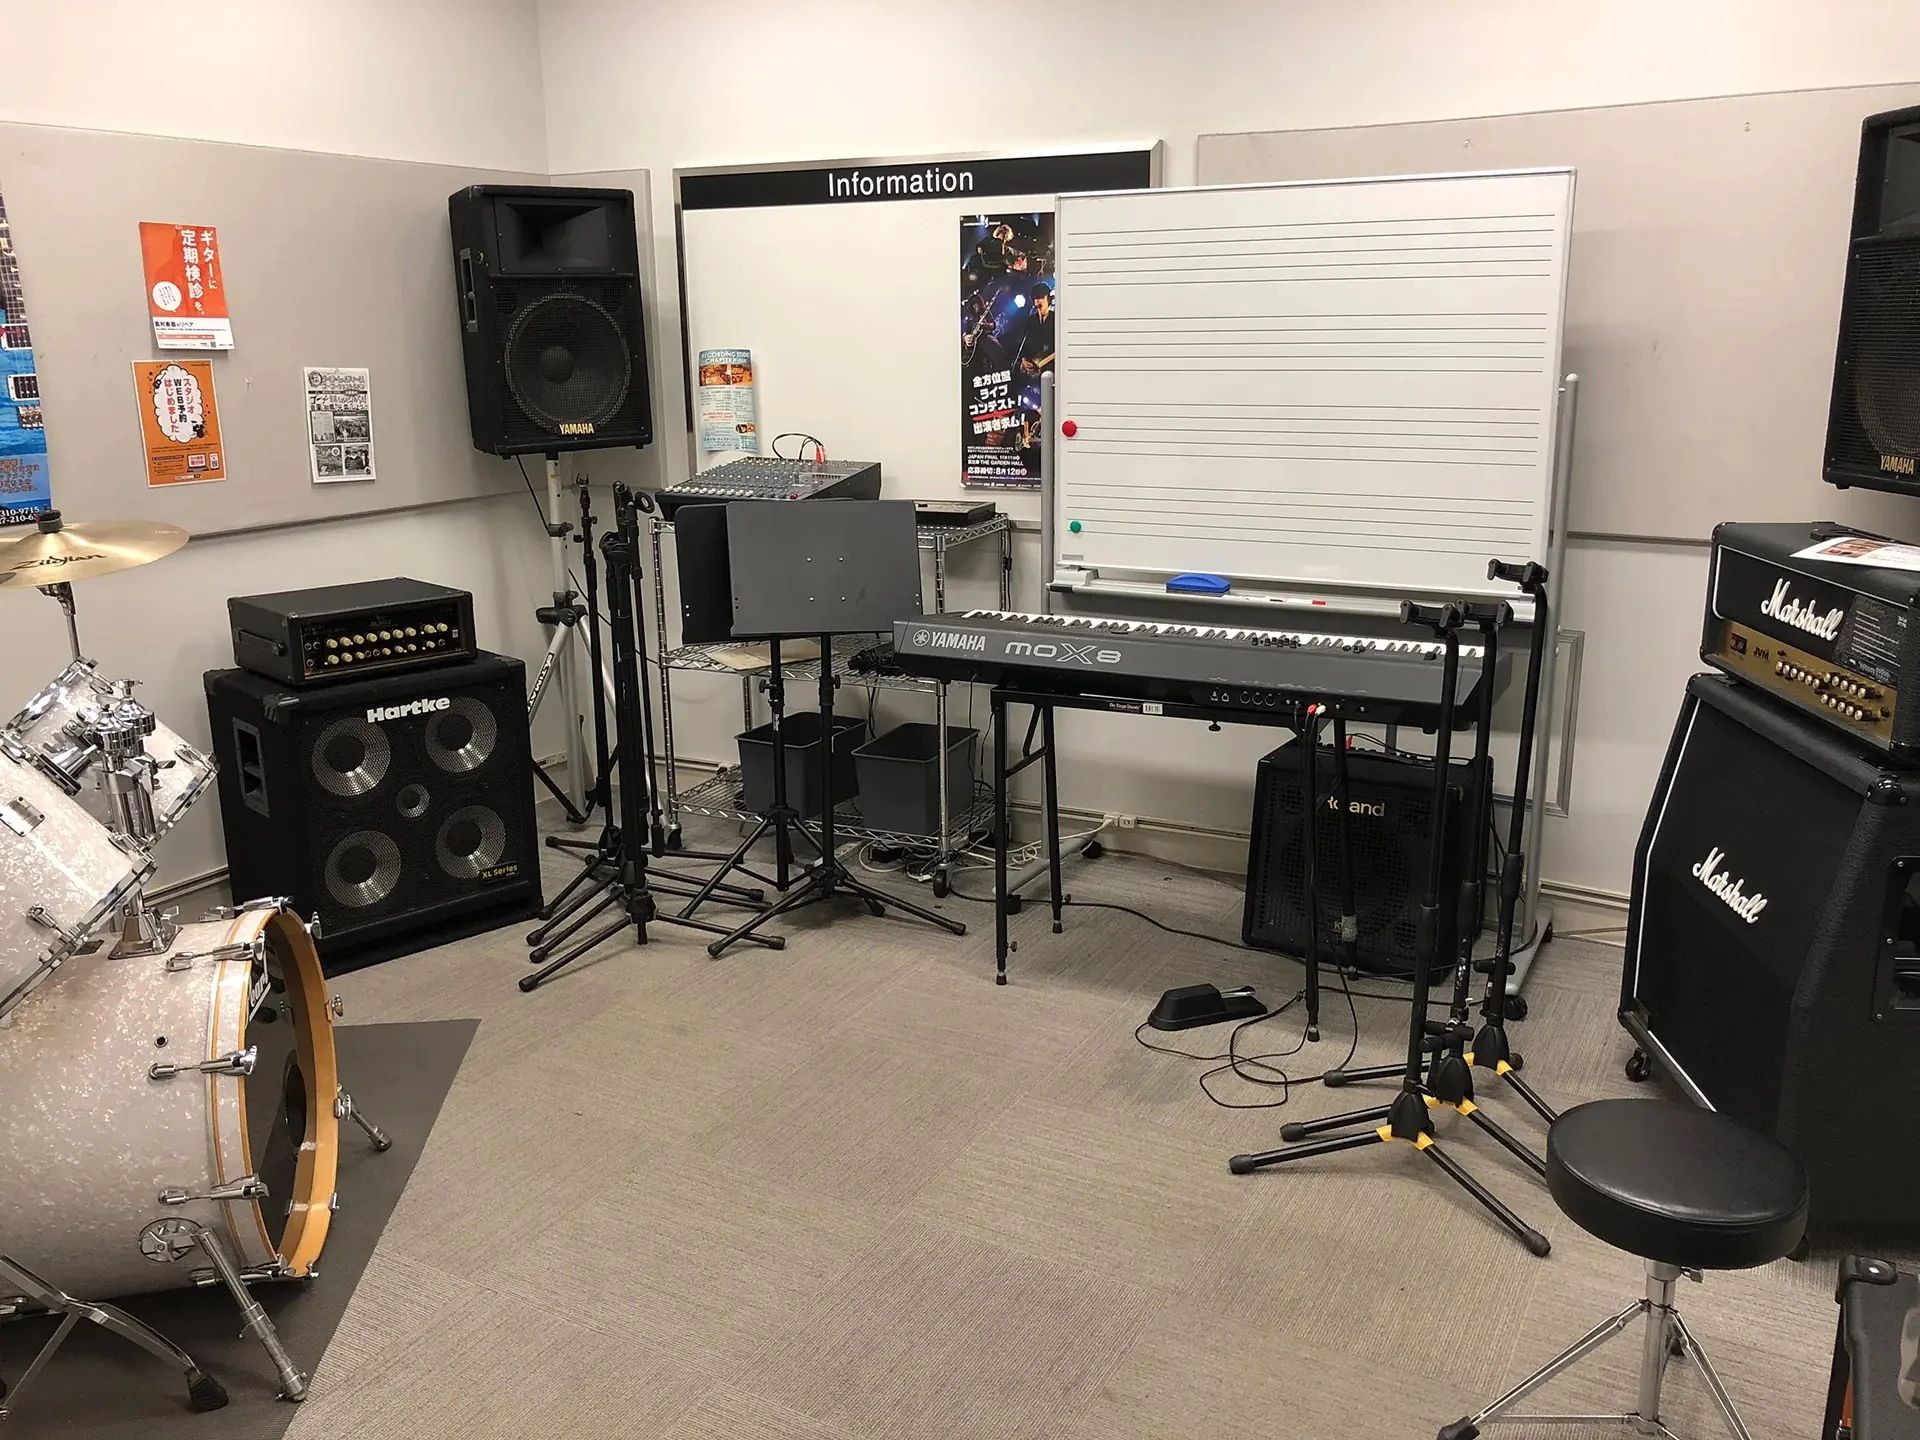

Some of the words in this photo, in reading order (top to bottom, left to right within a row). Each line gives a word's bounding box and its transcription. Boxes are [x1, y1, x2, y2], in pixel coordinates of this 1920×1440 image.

[828, 168, 974, 197] Information
[200, 229, 218, 290] ギターに
[173, 378, 188, 423] WEB予約
[183, 378, 195, 414] スタジオ
[979, 384, 1008, 401] ライブ
[163, 378, 180, 434] はじめました
[559, 422, 595, 435] YAMAHA
[1880, 454, 1915, 475] YAMAHA
[0, 513, 35, 525] 7-210-6
[9, 554, 108, 572] Zildjian
[1760, 577, 1844, 642] Marshall
[930, 630, 987, 652] YAMAHA
[1752, 646, 1770, 661] JVM
[366, 696, 451, 724] Hartke
[482, 870, 492, 879] XL
[493, 864, 518, 876] Series
[1692, 846, 1768, 924] Marshall
